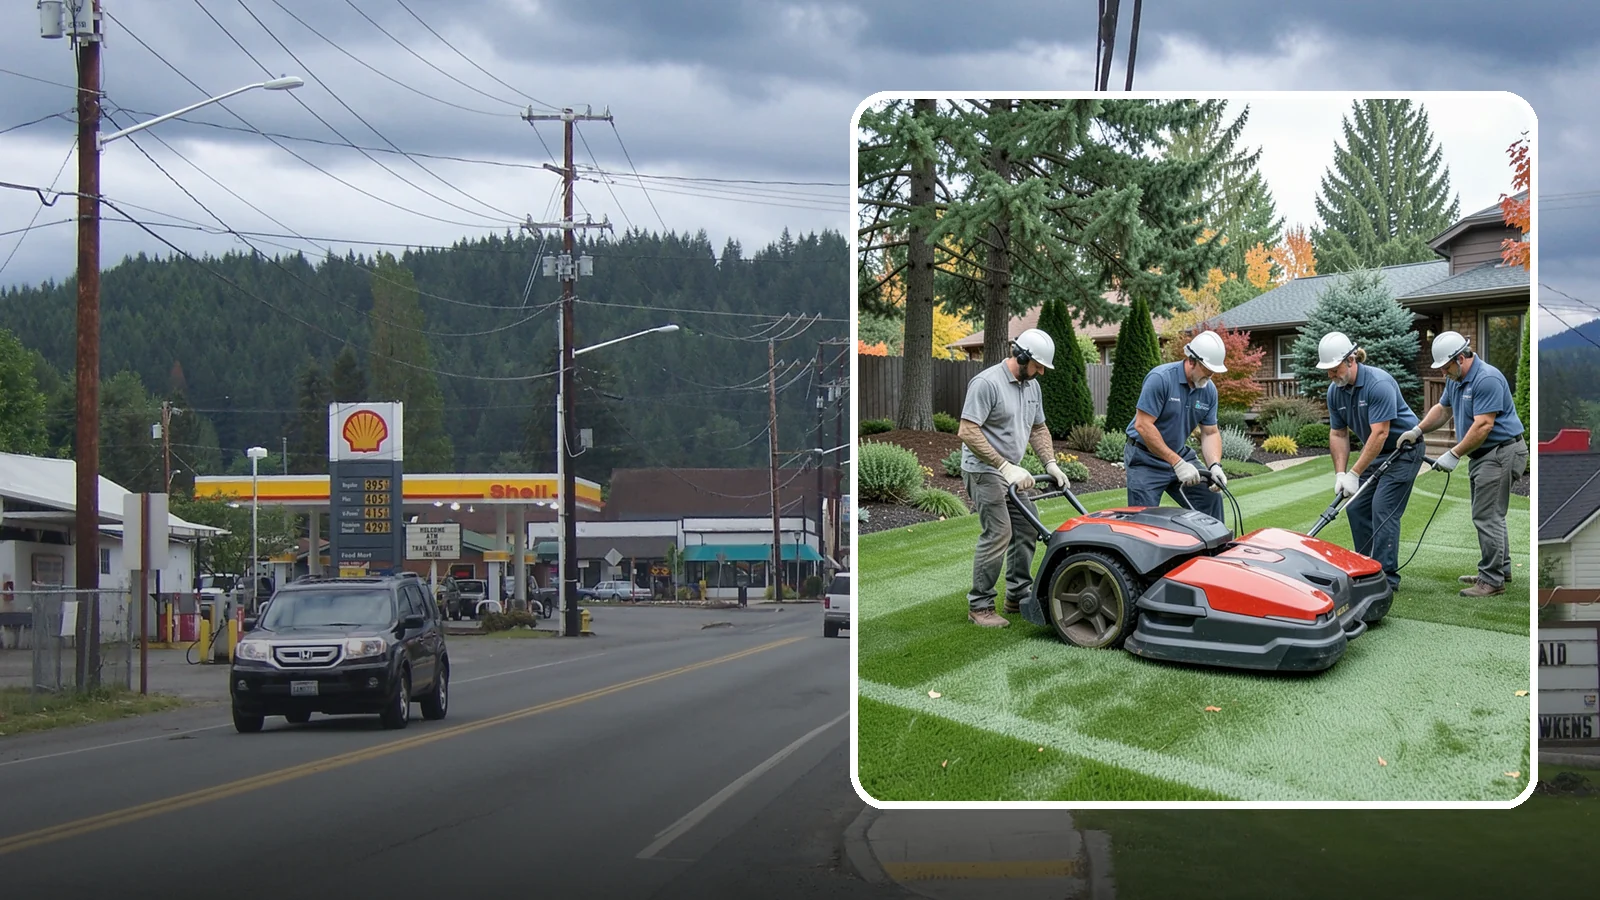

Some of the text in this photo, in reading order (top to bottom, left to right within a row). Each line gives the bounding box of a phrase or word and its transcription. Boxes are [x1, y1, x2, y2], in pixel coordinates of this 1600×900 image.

[366, 480, 383, 490] 395
[490, 484, 547, 498] Shell
[366, 494, 383, 504] 405
[366, 508, 383, 518] 415
[366, 522, 383, 532] 429
